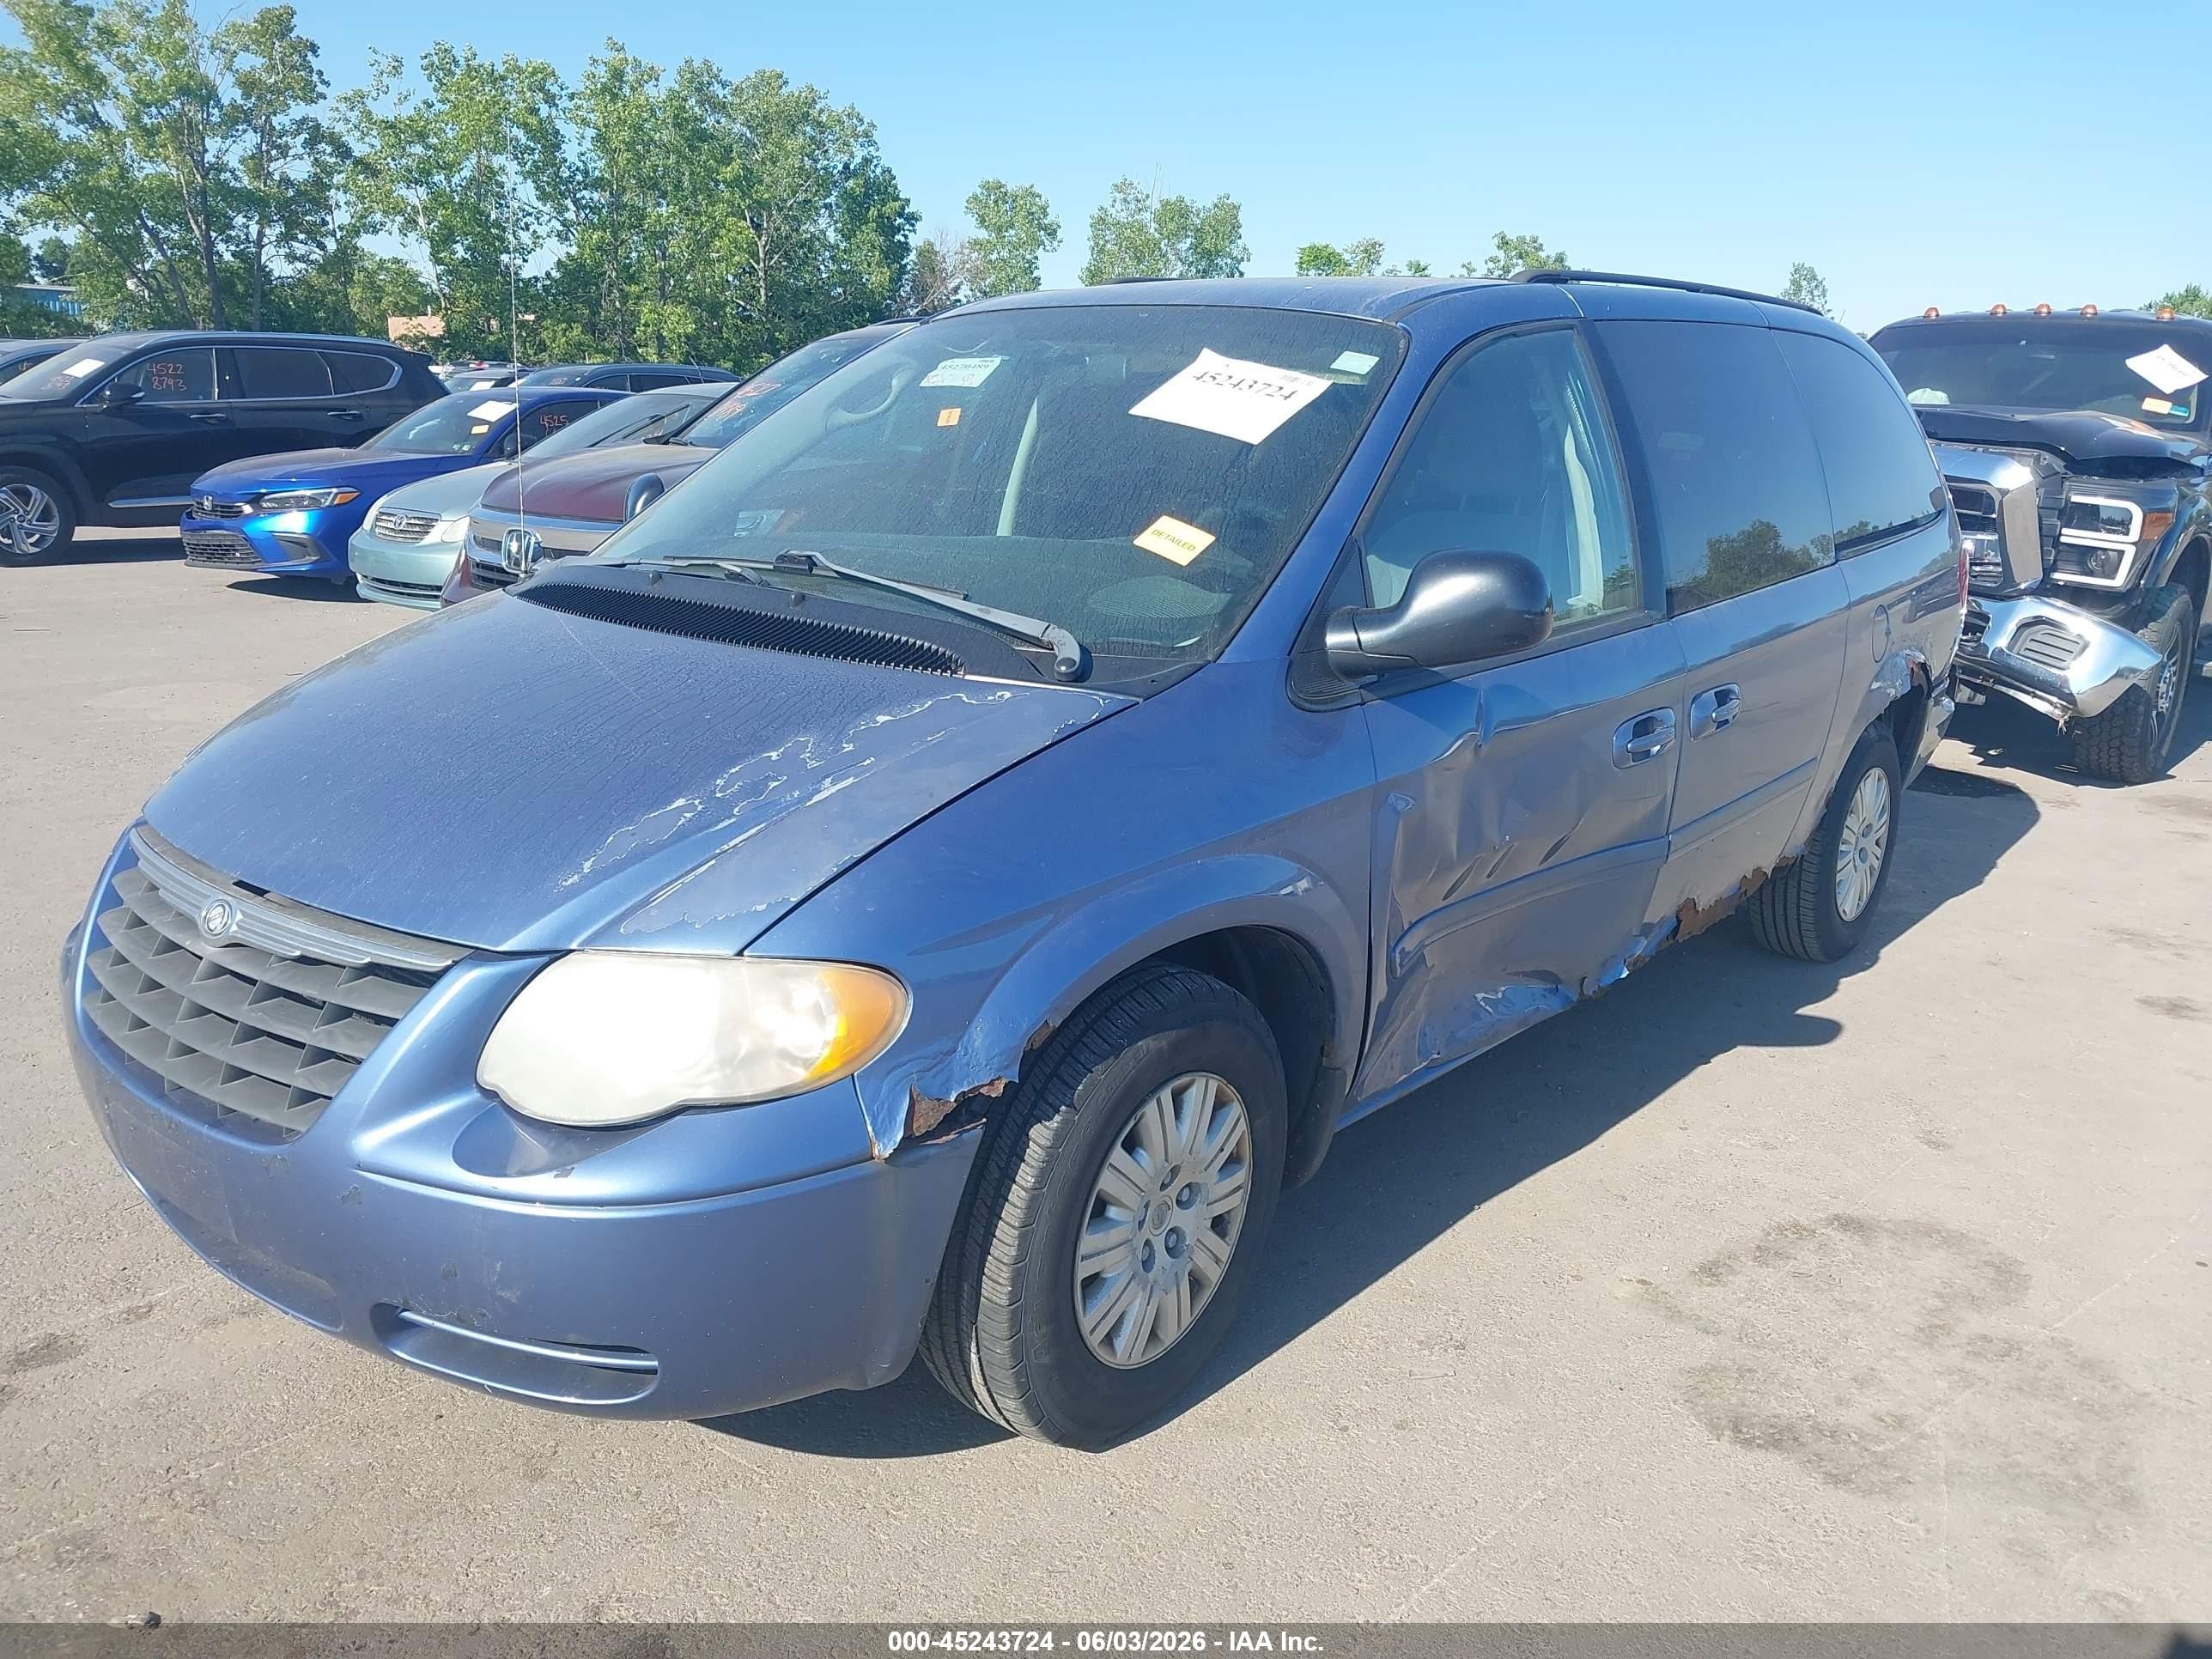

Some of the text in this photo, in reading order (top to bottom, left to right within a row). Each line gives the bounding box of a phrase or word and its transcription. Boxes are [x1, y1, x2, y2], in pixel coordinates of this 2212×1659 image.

[146, 362, 185, 375] 4522
[151, 376, 187, 392] 8793
[1192, 370, 1298, 401] 45243724
[539, 415, 569, 427] 4525
[1151, 529, 1196, 551] DETAILED
